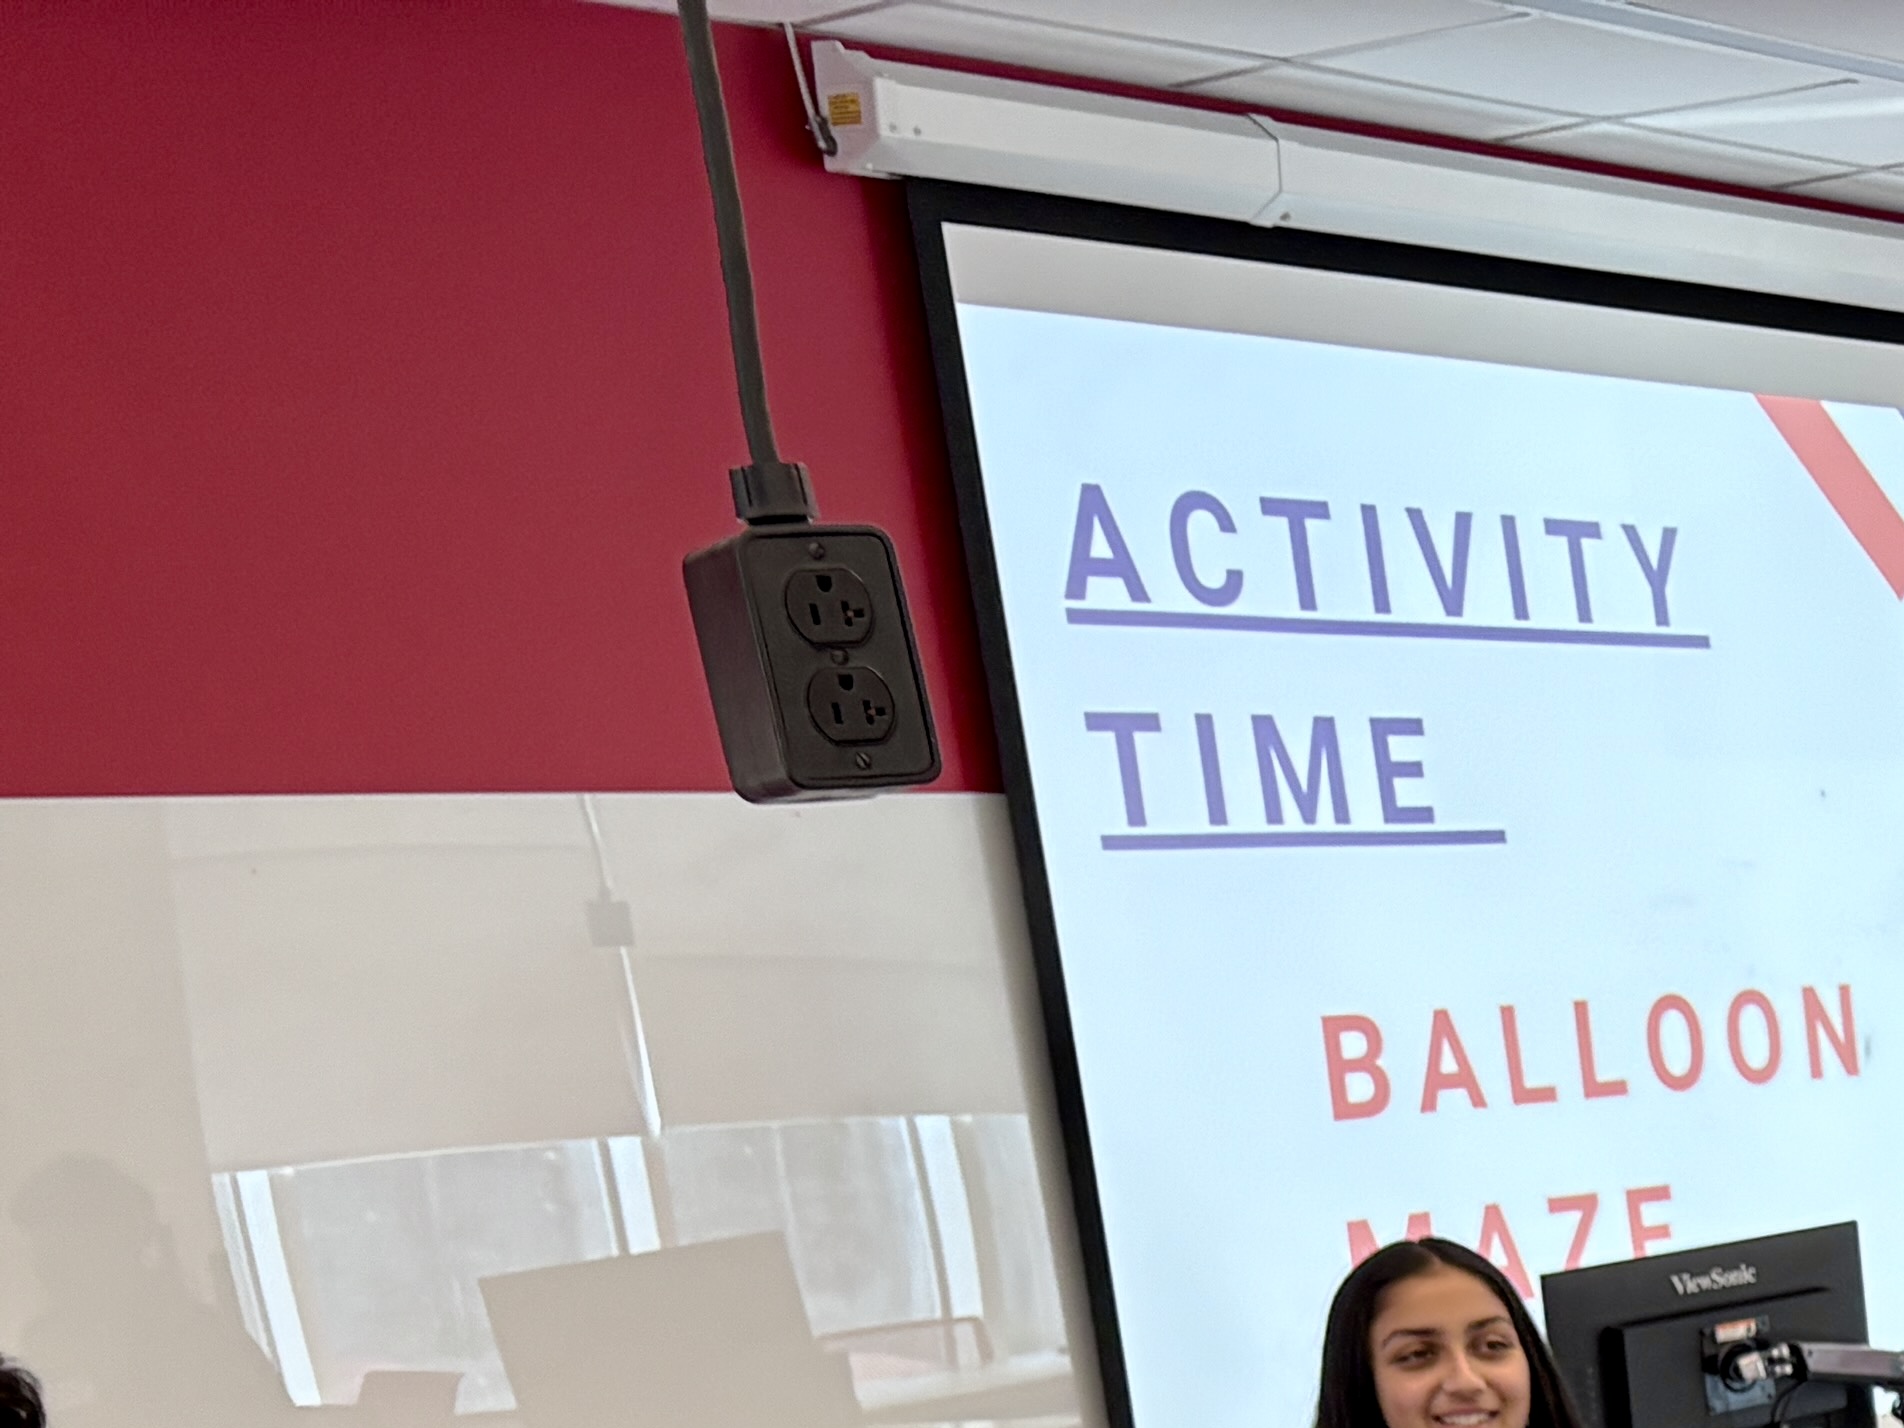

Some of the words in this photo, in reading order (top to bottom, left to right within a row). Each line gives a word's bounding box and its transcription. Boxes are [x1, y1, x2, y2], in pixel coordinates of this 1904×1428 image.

[1064, 482, 1678, 629] ACTIVITY
[1084, 710, 1436, 827] TIME
[1320, 983, 1862, 1122] BALLOON
[1669, 1262, 1758, 1296] ViewSonic
